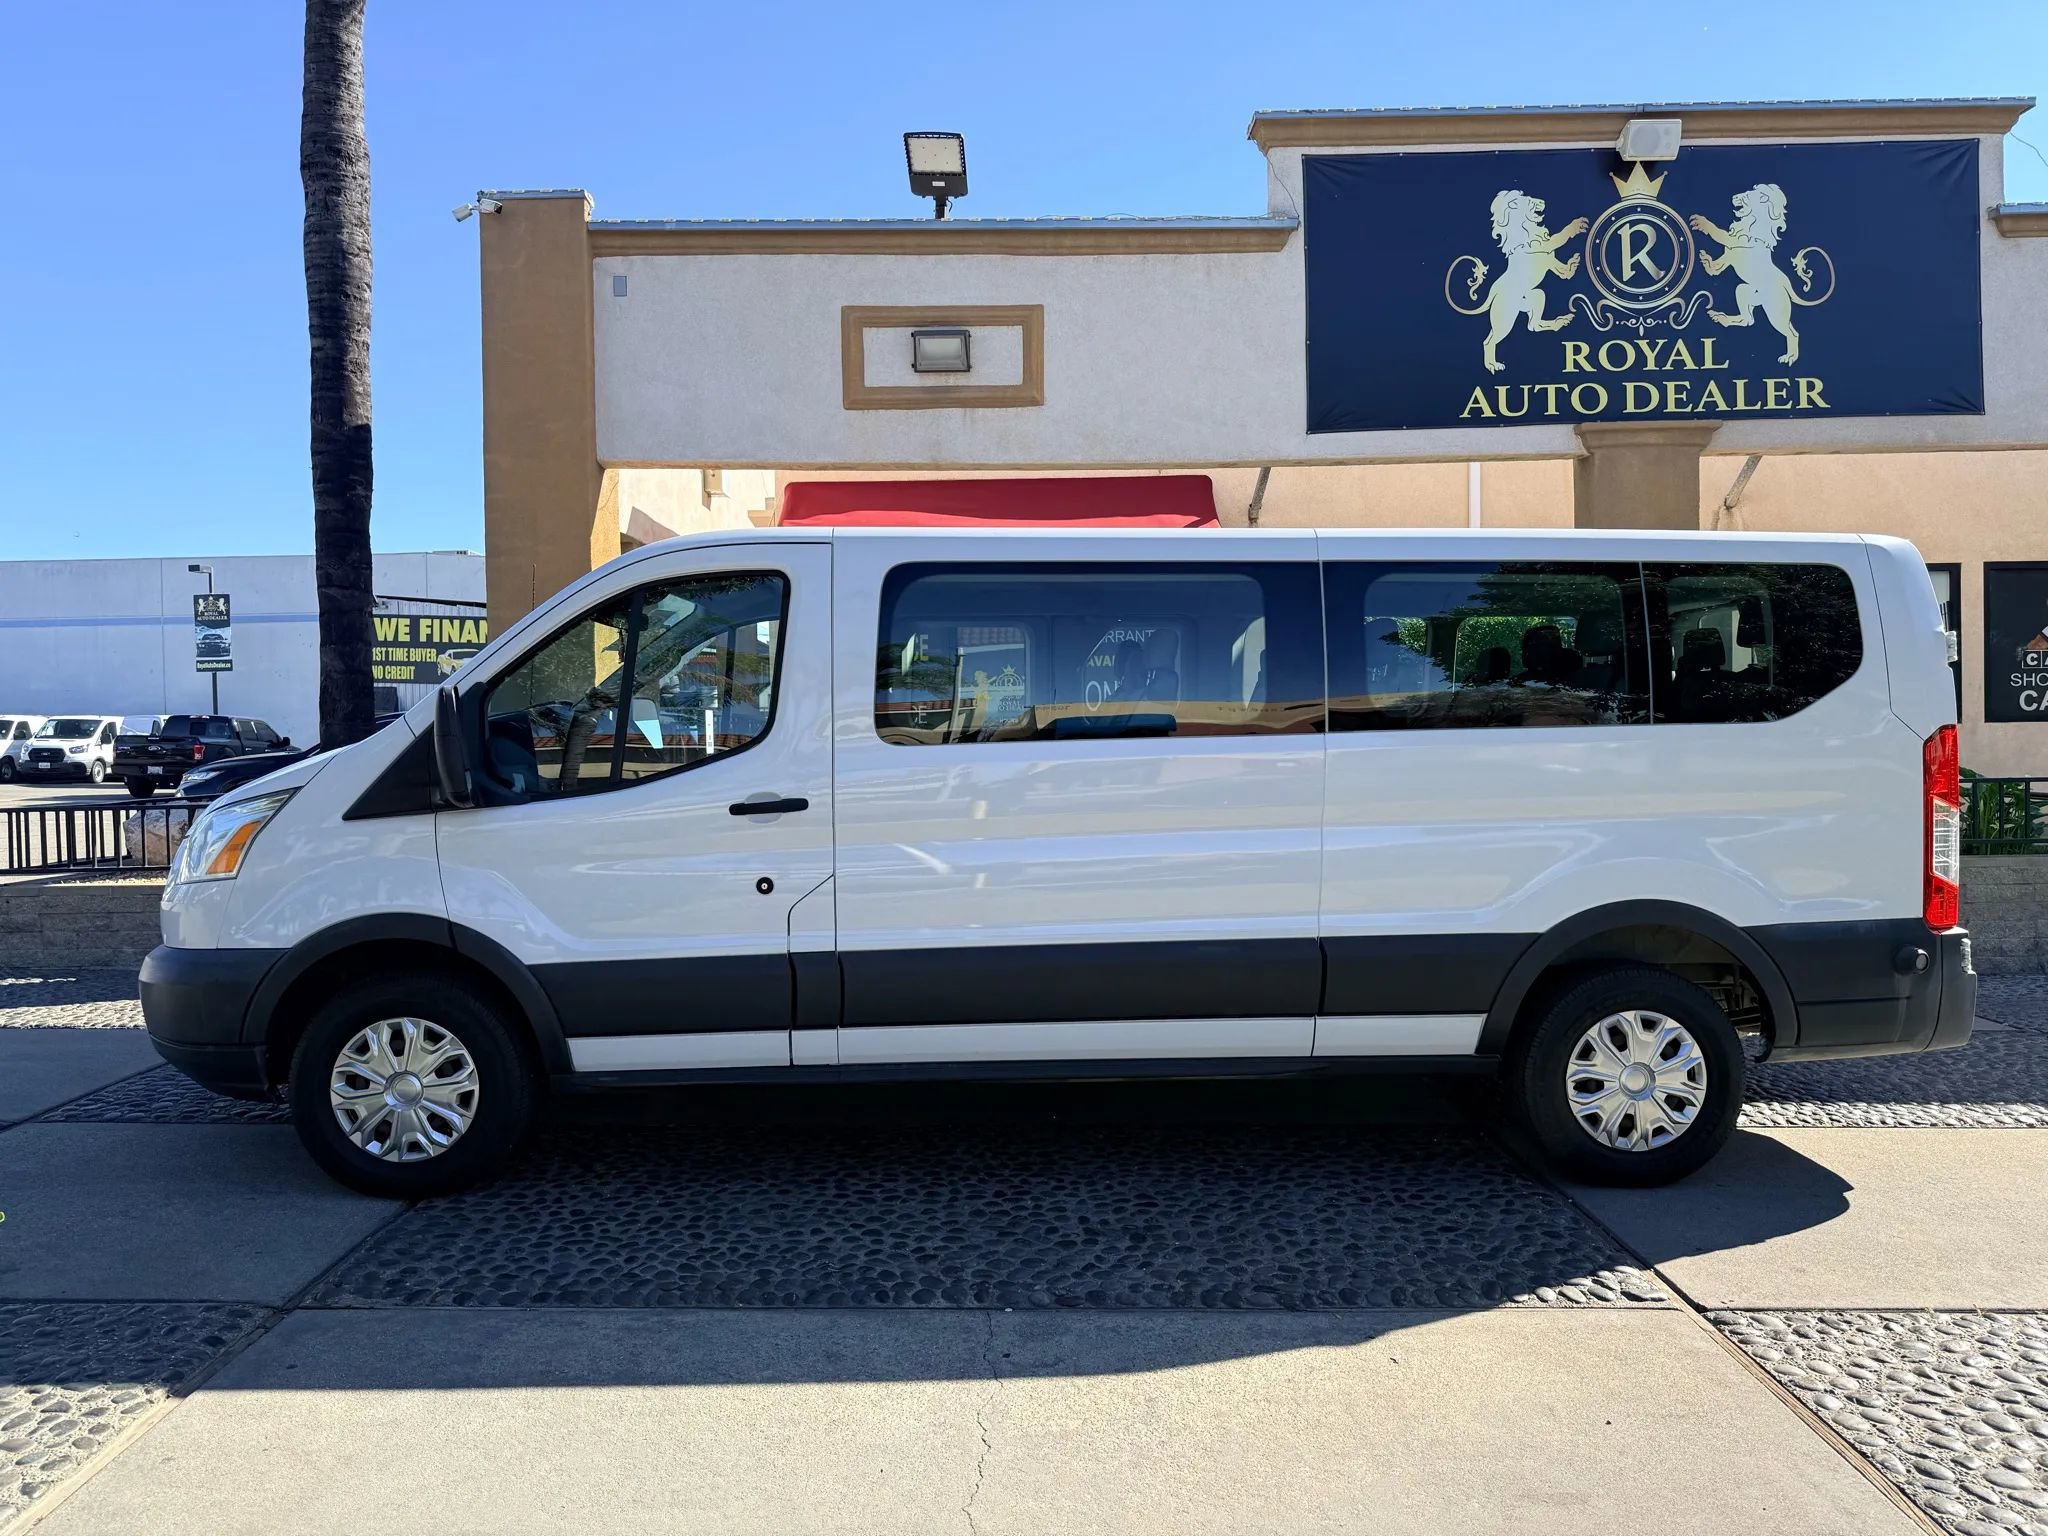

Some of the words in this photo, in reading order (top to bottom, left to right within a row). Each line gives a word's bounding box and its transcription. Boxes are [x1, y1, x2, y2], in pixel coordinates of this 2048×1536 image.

[1616, 222, 1666, 282] R
[1561, 337, 1729, 373] ROYAL
[1459, 383, 1608, 418] AUTO
[1622, 377, 1831, 413] DEALER
[373, 617, 411, 641] WE
[372, 647, 386, 661] 1ST
[387, 647, 408, 661] TIME
[409, 648, 437, 662] BUYER
[372, 665, 384, 679] NO
[385, 665, 415, 680] CREDIT
